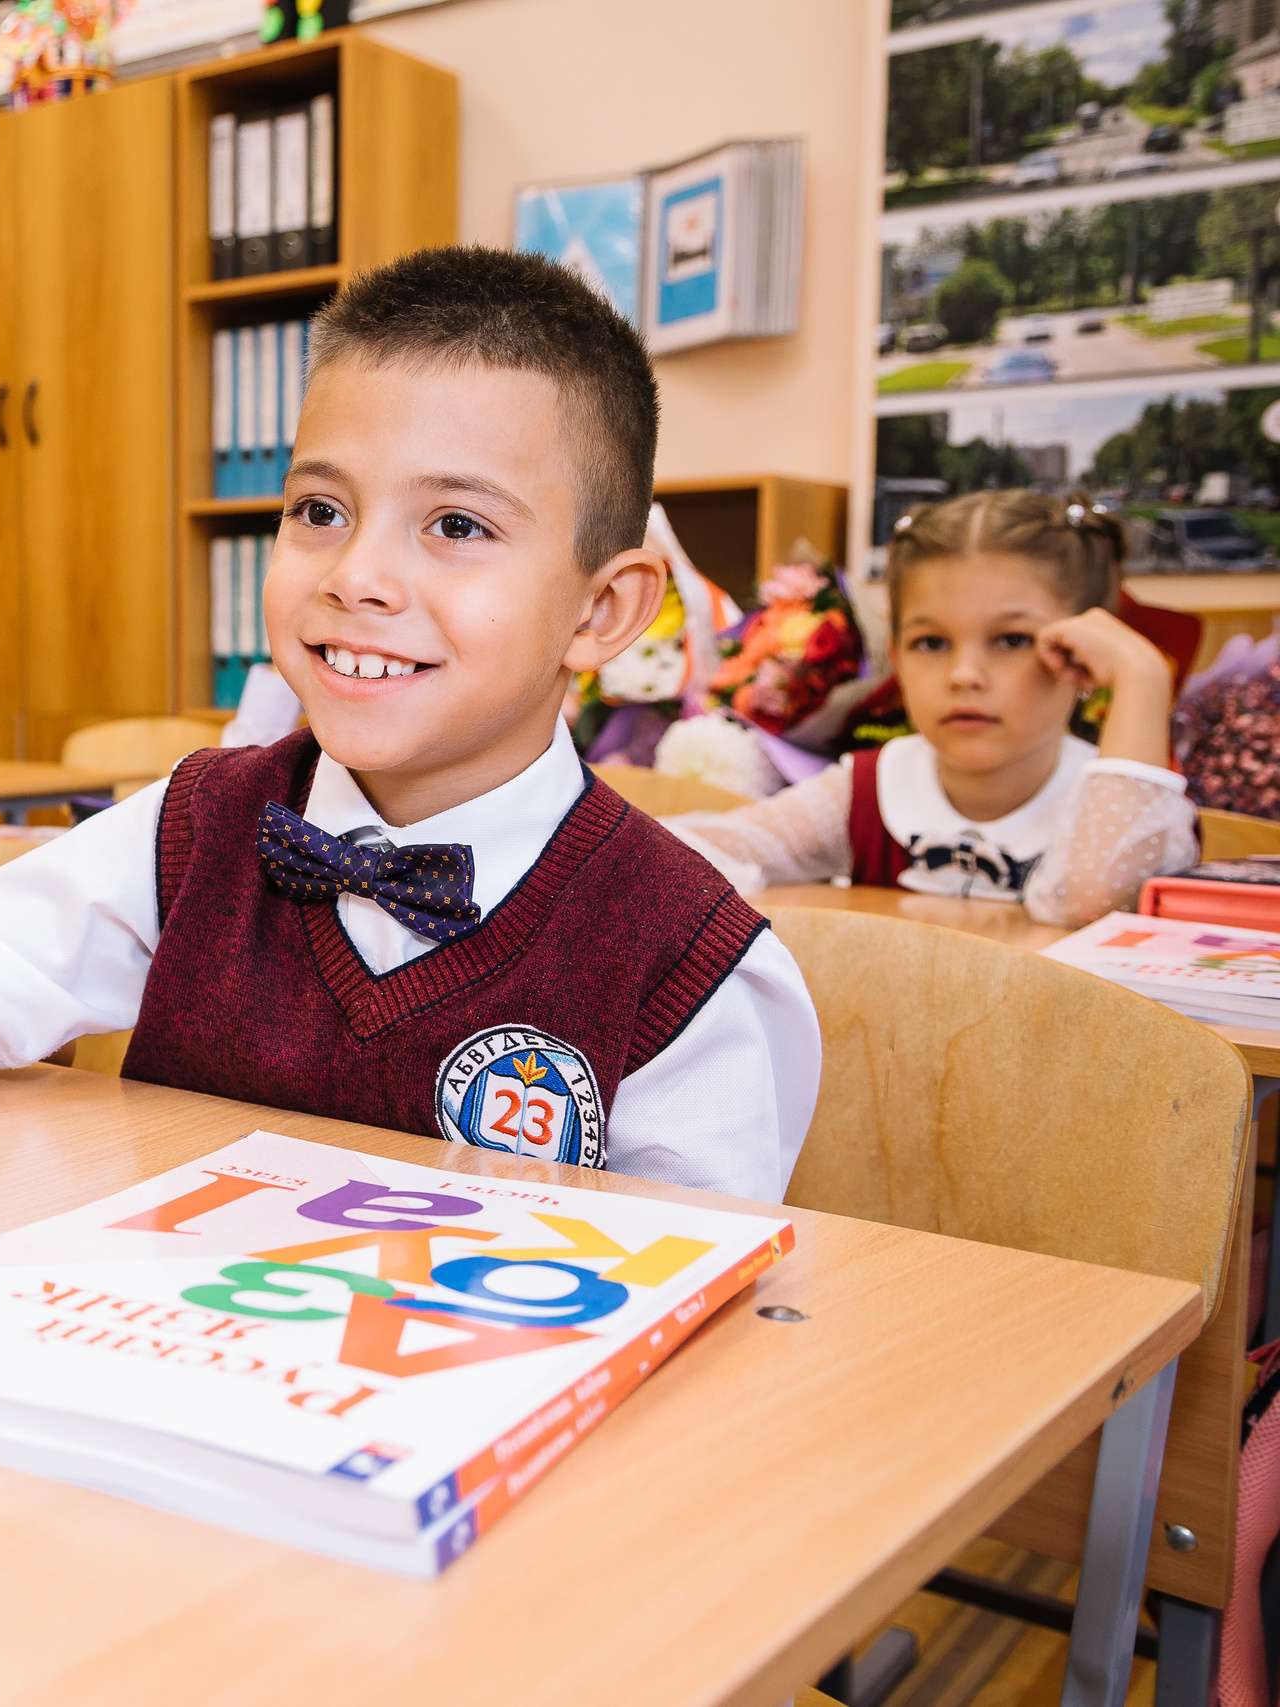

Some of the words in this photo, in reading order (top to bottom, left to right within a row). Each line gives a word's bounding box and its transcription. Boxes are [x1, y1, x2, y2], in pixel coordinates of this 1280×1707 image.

[489, 1088, 555, 1146] 23
[571, 1073, 598, 1168] 12345
[102, 1170, 298, 1236] 1
[219, 1164, 310, 1187] класс
[465, 1186, 560, 1206] Часть
[34, 1319, 386, 1419] Русский
